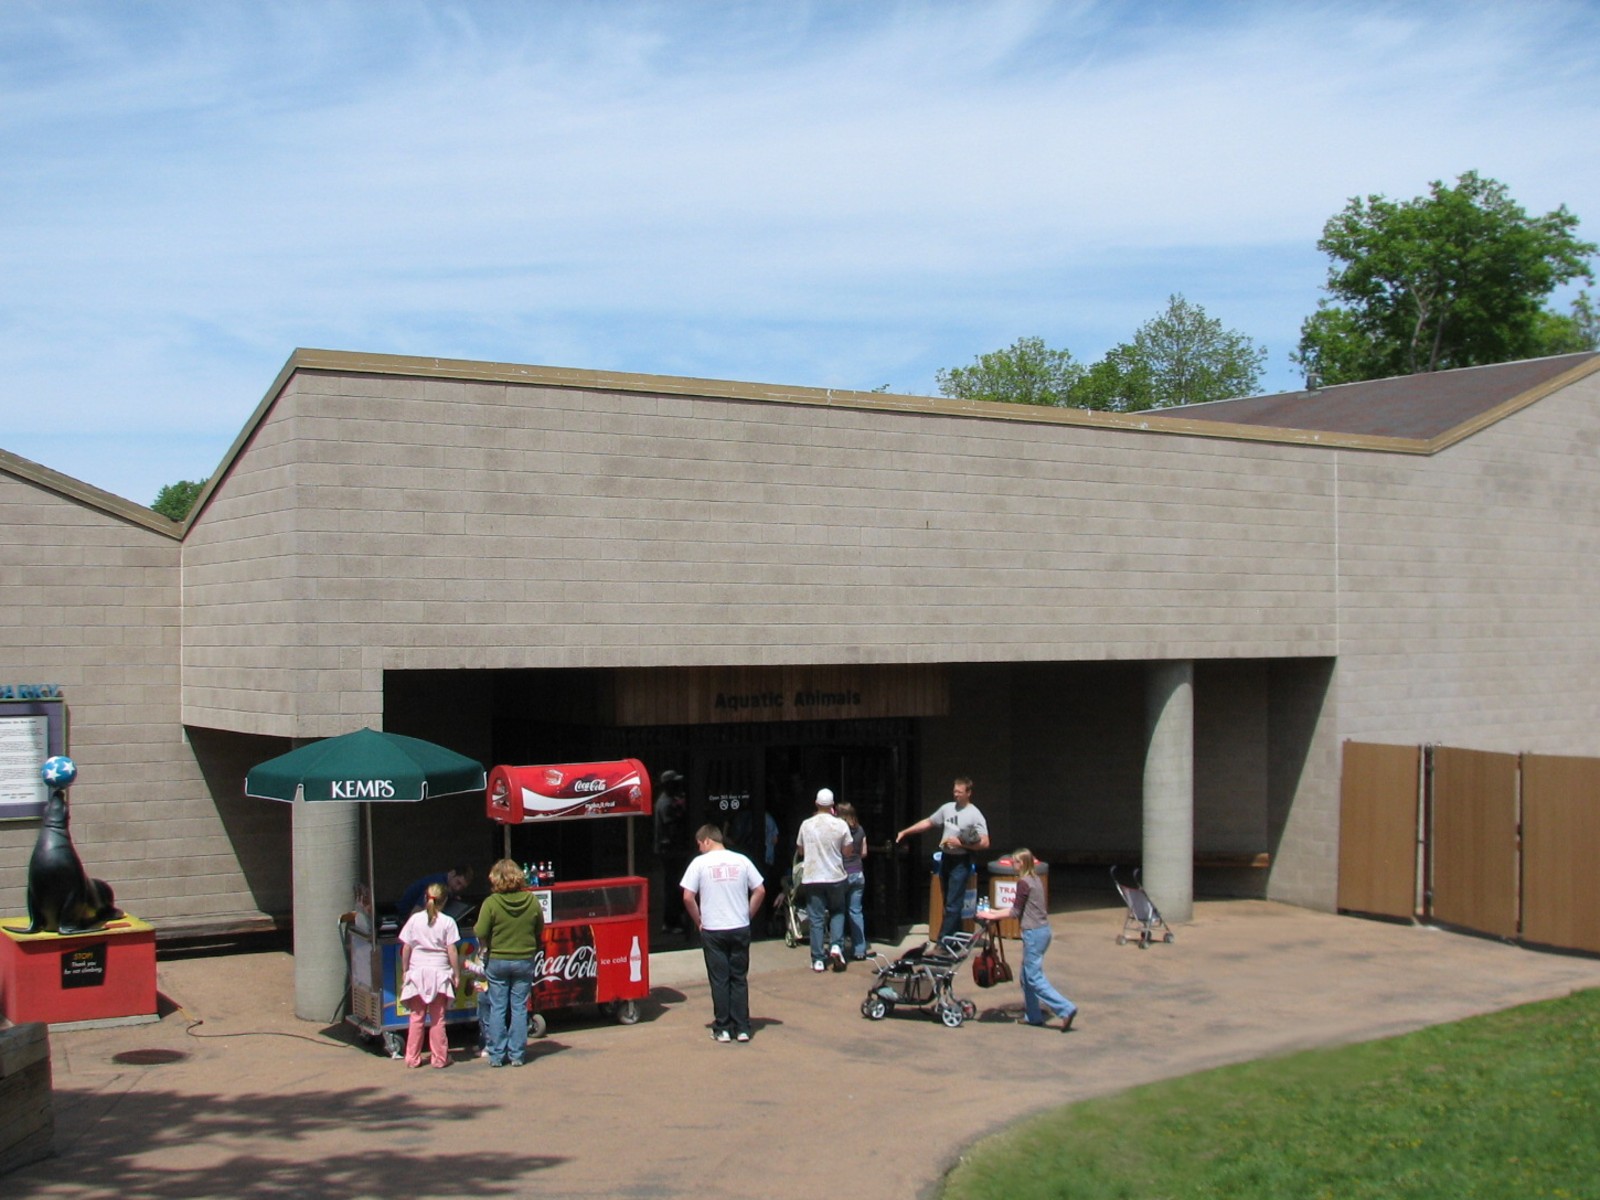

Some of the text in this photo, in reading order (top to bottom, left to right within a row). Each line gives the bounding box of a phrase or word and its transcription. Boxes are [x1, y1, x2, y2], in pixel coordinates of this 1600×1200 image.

[0, 684, 59, 698] ARKY
[715, 690, 861, 710] Aquatic Animals
[331, 780, 395, 798] KEMPS
